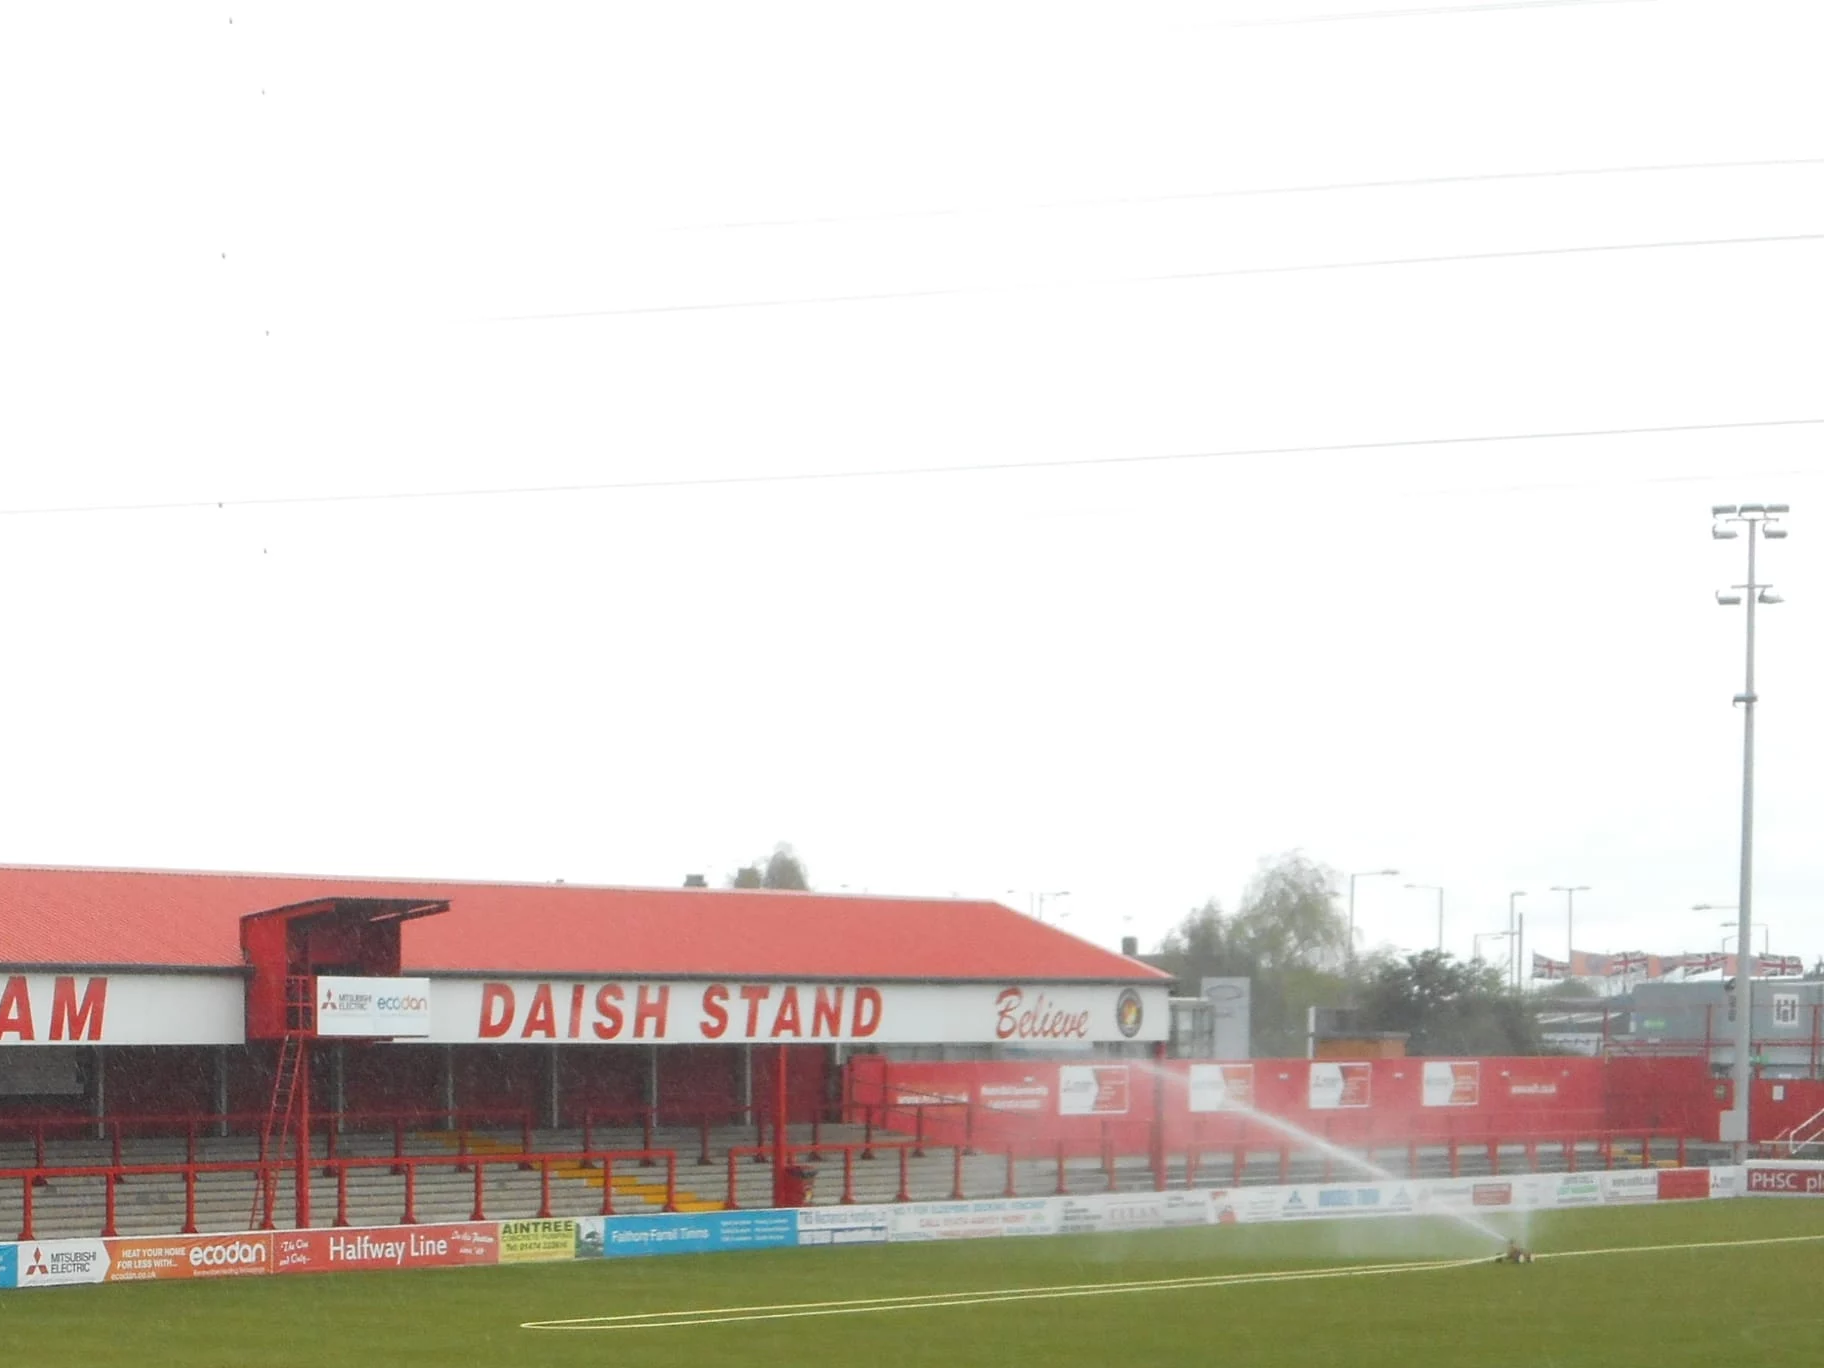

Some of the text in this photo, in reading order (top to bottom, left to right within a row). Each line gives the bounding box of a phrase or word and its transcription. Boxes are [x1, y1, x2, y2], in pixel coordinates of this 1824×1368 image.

[377, 995, 428, 1010] ecodan
[478, 983, 671, 1040] DAISH
[699, 984, 883, 1040] STAND
[994, 986, 1088, 1039] Believe
[1752, 1171, 1798, 1189] PHSC
[502, 1220, 573, 1234] AINTREE
[142, 1247, 163, 1257] YOUR
[164, 1247, 186, 1256] HOME
[188, 1241, 266, 1266] ecodan
[329, 1235, 406, 1265] Halfway
[410, 1233, 448, 1257] Line
[51, 1251, 96, 1263] MITSUBISHI
[51, 1262, 90, 1274] ELECTRIC
[117, 1261, 133, 1270] FOR
[134, 1260, 152, 1269] LESS
